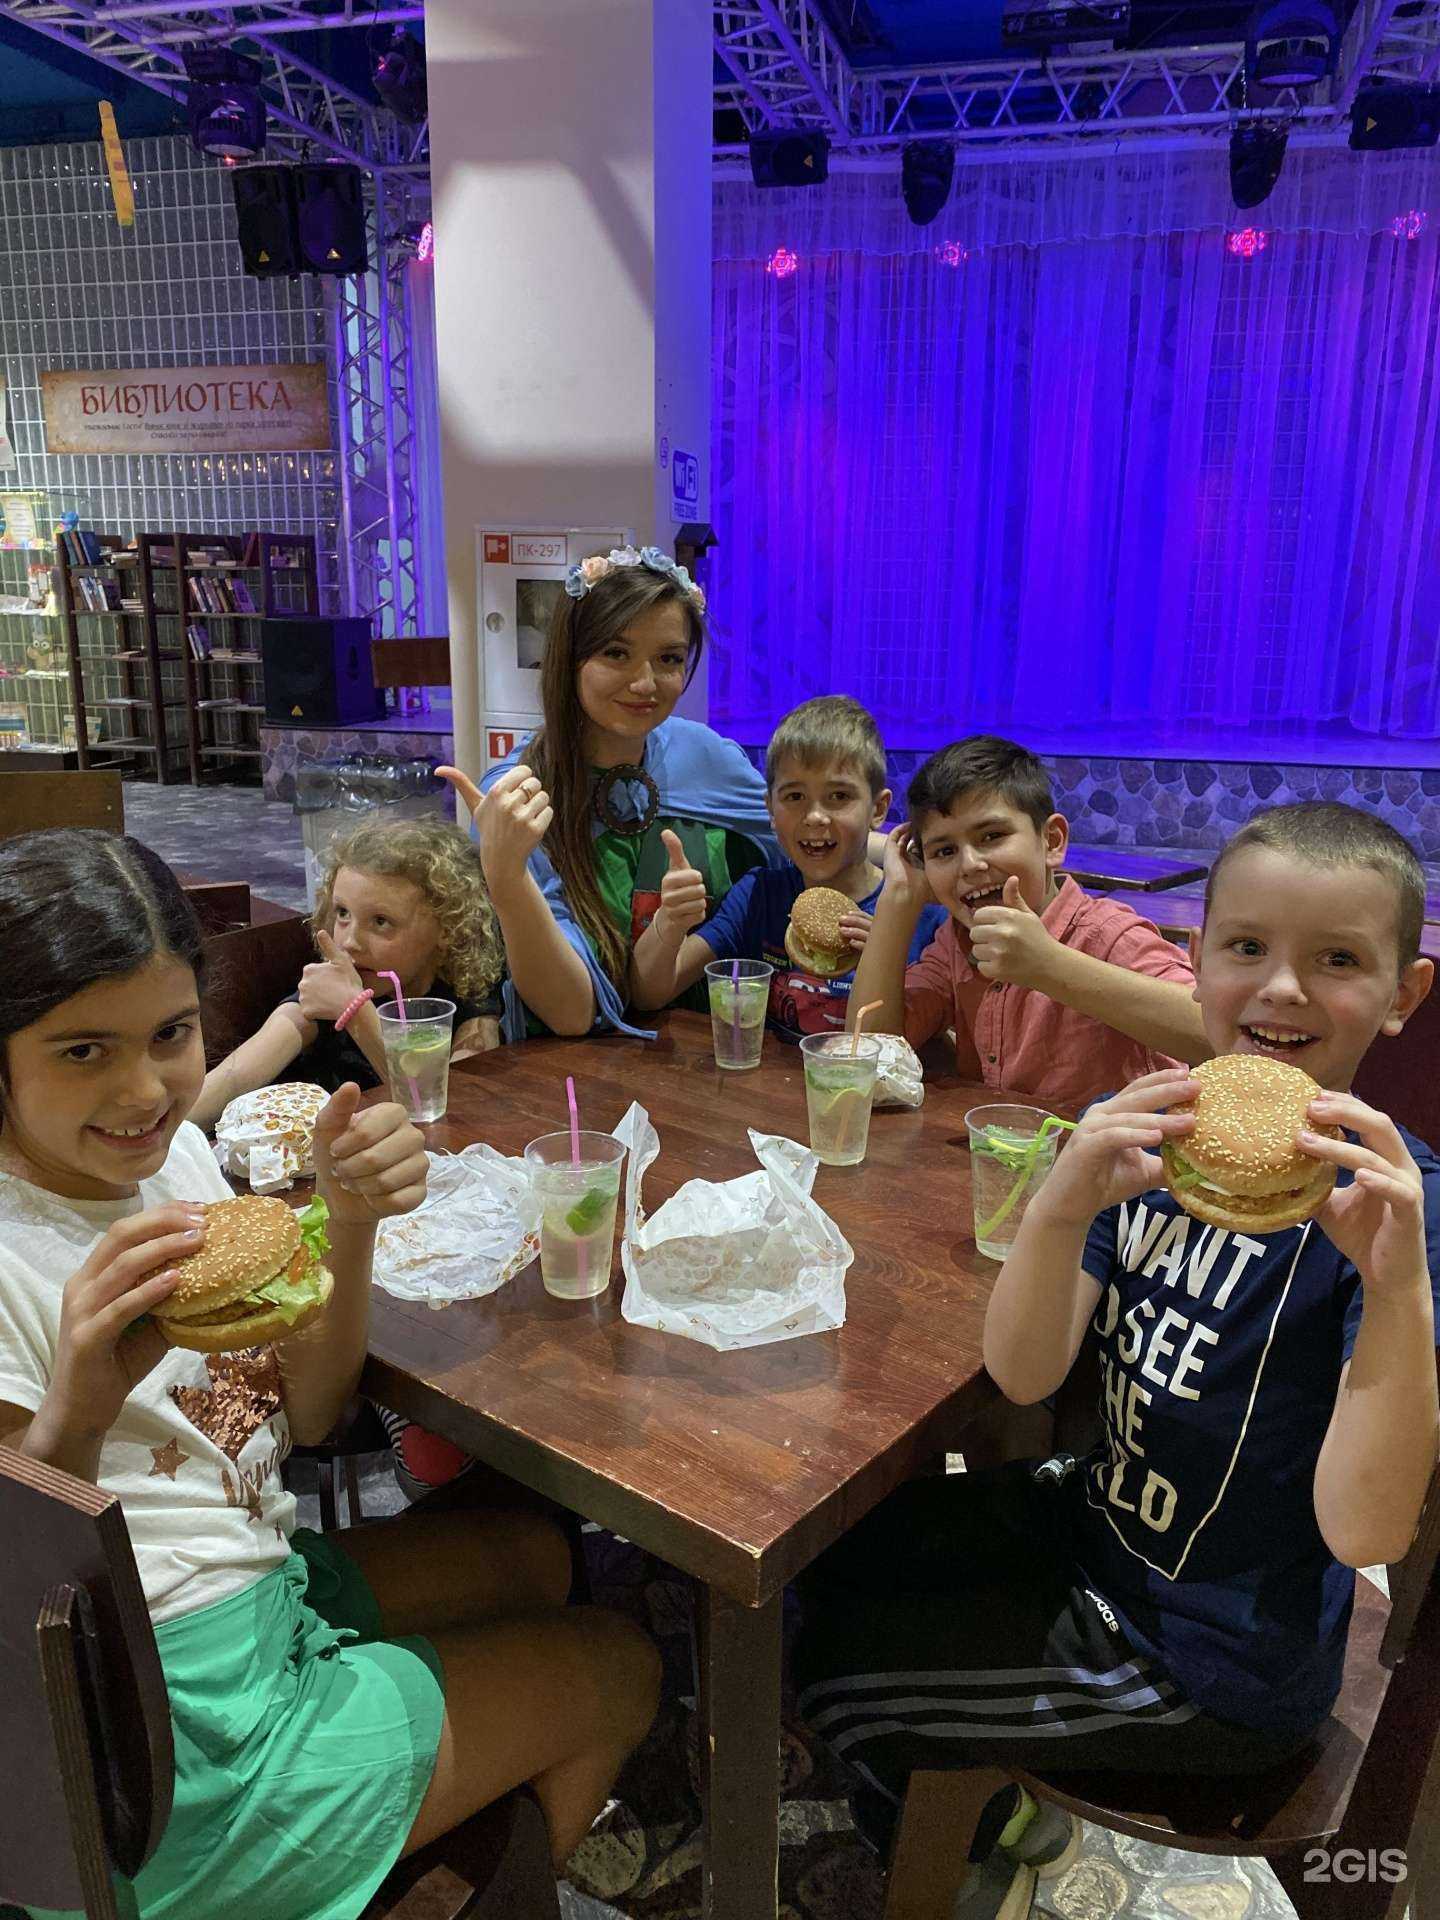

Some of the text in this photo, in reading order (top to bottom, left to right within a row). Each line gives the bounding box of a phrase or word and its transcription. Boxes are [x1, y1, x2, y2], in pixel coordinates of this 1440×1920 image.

[81, 381, 292, 418] БИБЛИОТЕКА
[518, 543, 561, 558] ПК-297
[1117, 1200, 1267, 1311] WANT
[1117, 1299, 1220, 1401] SEE
